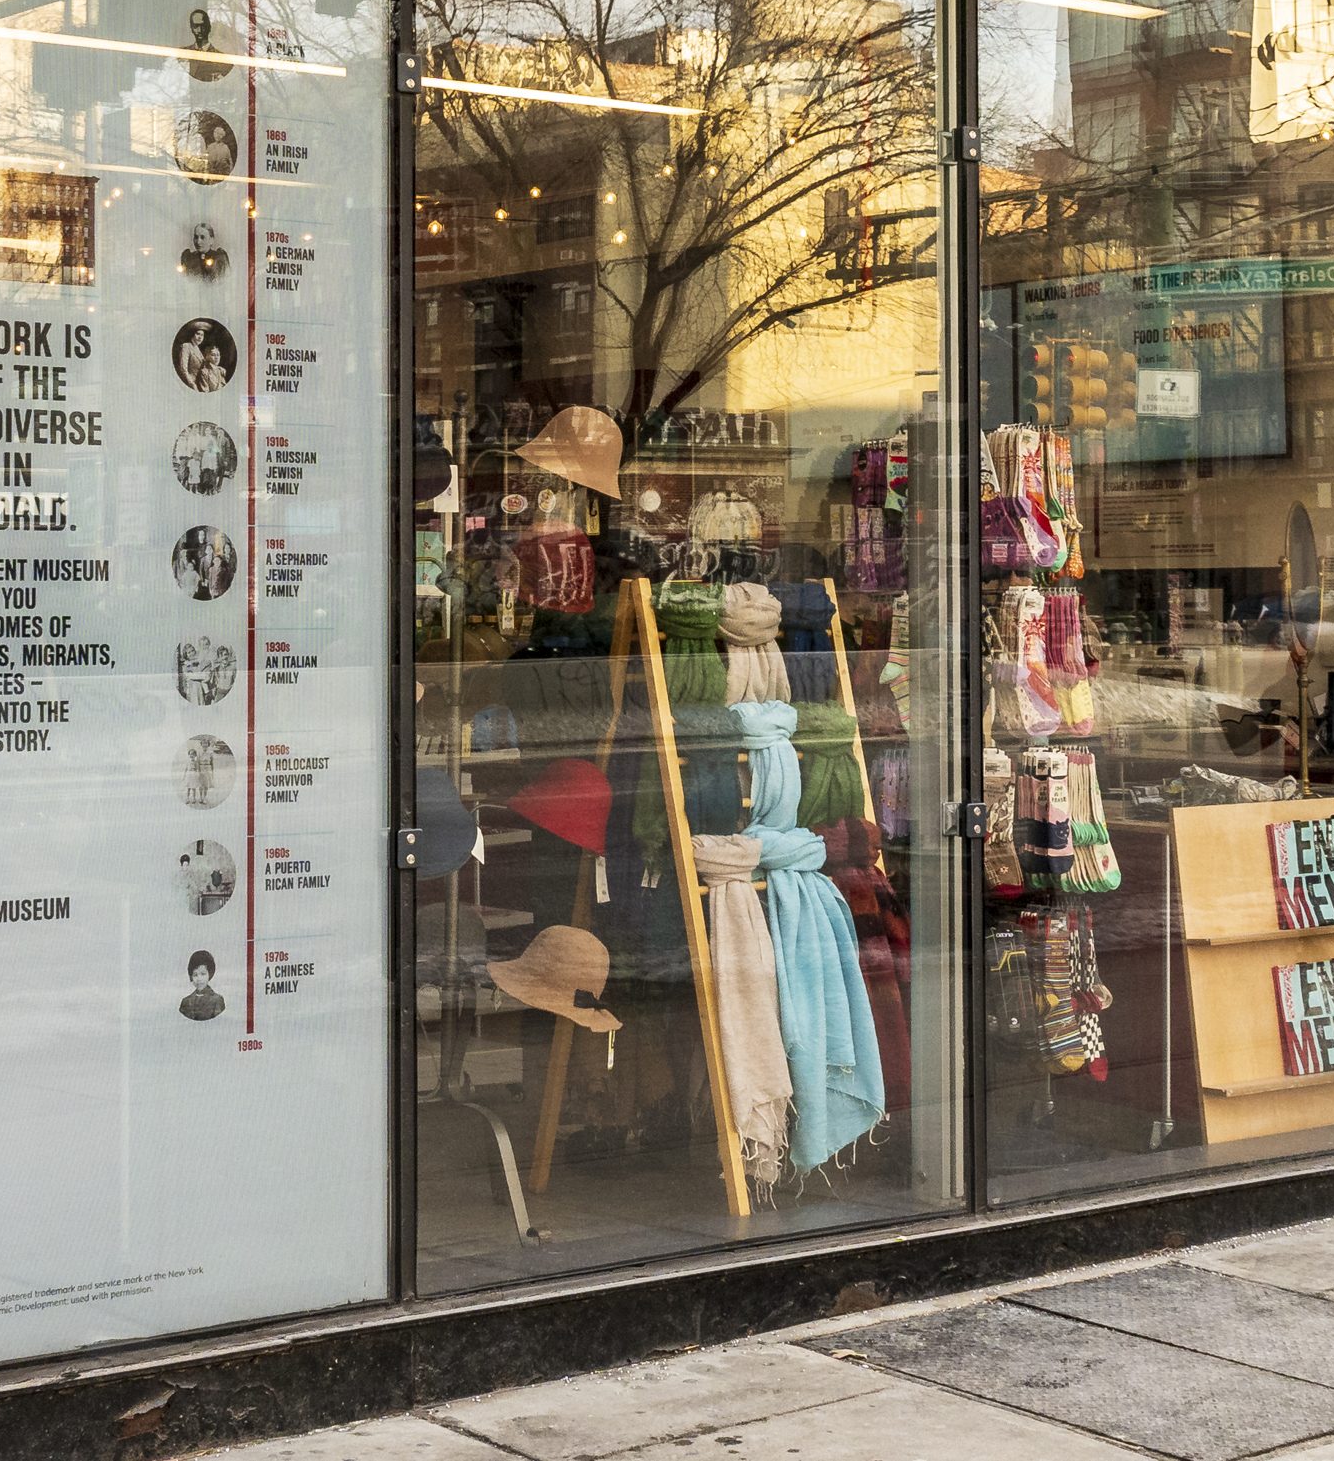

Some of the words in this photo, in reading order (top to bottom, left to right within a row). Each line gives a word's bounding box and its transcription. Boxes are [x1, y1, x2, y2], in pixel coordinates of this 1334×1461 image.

[265, 130, 287, 141] 1869
[266, 144, 279, 157] AN
[282, 145, 308, 159] IRISH
[266, 159, 299, 174] FAMILY
[265, 232, 289, 244] 1870s
[266, 246, 272, 258] A
[275, 247, 315, 261] GERMAN
[266, 262, 303, 276] JEWISH
[266, 276, 299, 291] FAMILY
[1133, 274, 1158, 292] MEET
[1161, 271, 1180, 289] THE
[1024, 283, 1066, 305] WALKING
[1070, 281, 1101, 299] TOURS
[265, 334, 286, 345] 1902
[1133, 327, 1159, 345] FOOD
[1163, 321, 1231, 343] EXPERIENCES
[64, 324, 91, 359] IS
[265, 348, 273, 361] A
[276, 349, 317, 363] RUSSIAN
[265, 364, 303, 378] JEWISH
[14, 365, 67, 402] THE
[265, 379, 299, 393] FAMILY
[265, 436, 289, 448] 1910s
[265, 451, 273, 464] A
[276, 451, 317, 464] RUSSIAN
[3, 452, 32, 487] IN
[265, 466, 303, 480] JEWISH
[265, 481, 299, 495] FAMILY
[265, 539, 286, 550] 1916
[265, 553, 273, 566] A
[276, 553, 328, 566] SEPHARDIC
[33, 559, 109, 582] MUSEUM
[265, 568, 303, 582] JEWISH
[2, 588, 36, 609] YOU
[265, 584, 299, 598] FAMILY
[49, 616, 72, 637] OF
[265, 642, 290, 653] 1930s
[22, 643, 116, 669] MIGRANTS,
[265, 656, 279, 669] AN
[282, 655, 318, 668] ITALIAN
[265, 671, 299, 685] FAMILY
[38, 701, 69, 722] THE
[265, 745, 290, 756] 1950s
[265, 759, 273, 772] A
[276, 757, 329, 771] HOLOCAUST
[265, 773, 313, 788] SURVIVOR
[265, 789, 299, 804] FAMILY
[264, 847, 290, 859] 1960s
[264, 862, 272, 875] A
[275, 860, 311, 875] PUERTO
[264, 877, 295, 892] RICAN
[297, 874, 331, 890] FAMILY
[264, 951, 289, 963] 1970s
[264, 965, 272, 979] A
[275, 963, 315, 978] CHINESE
[264, 981, 299, 995] FAMILY
[237, 1039, 263, 1052] 1980s
[34, 1285, 75, 1297] trademark
[77, 1282, 93, 1292] and
[94, 1278, 121, 1290] service
[123, 1274, 143, 1285] mark
[144, 1273, 153, 1282] of
[154, 1271, 166, 1280] the
[168, 1269, 186, 1279] New
[187, 1266, 204, 1277] York
[70, 1293, 89, 1305] used
[91, 1290, 109, 1301] with
